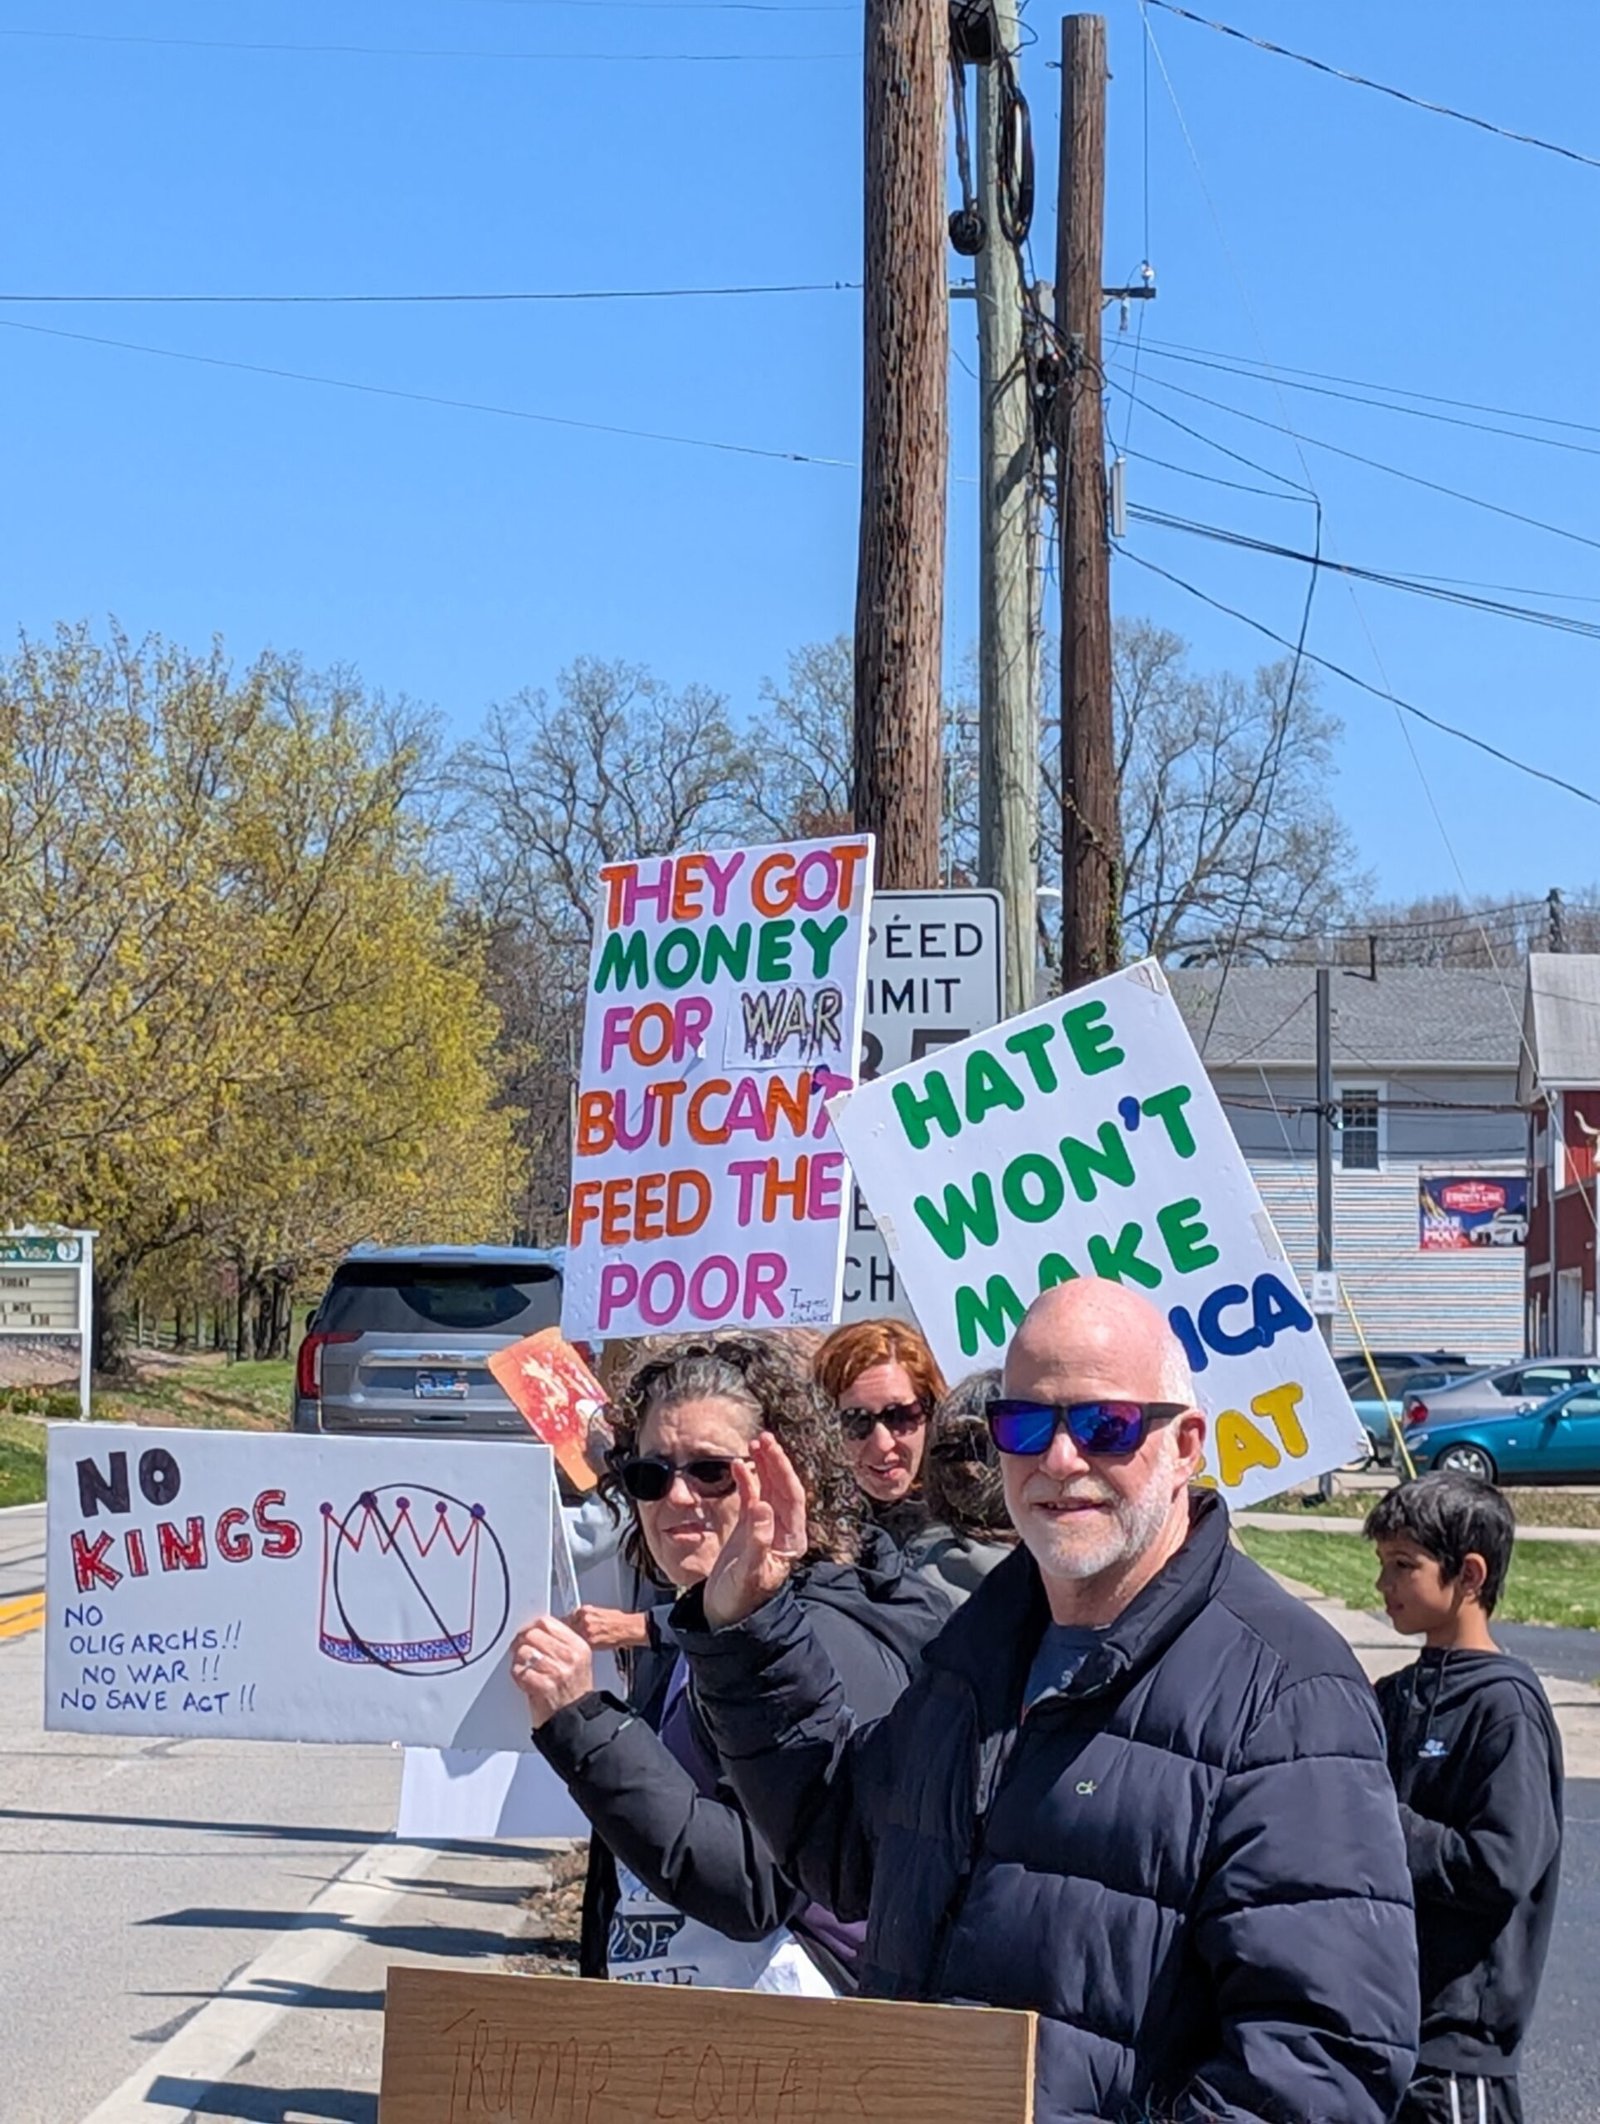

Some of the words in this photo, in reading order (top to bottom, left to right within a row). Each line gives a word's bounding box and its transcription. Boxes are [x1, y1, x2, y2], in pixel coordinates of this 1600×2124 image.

[600, 851, 745, 930] THEY
[751, 845, 868, 918] GOT
[594, 915, 848, 994] MONEY
[868, 923, 984, 959] EED
[601, 996, 713, 1073] FOR
[741, 987, 843, 1062] WAR
[868, 978, 961, 1015] IMIT
[576, 1079, 688, 1157] BUT
[687, 1064, 854, 1145] CAN'T
[892, 1000, 1125, 1149] HATE
[570, 1169, 712, 1248] FEED
[727, 1152, 844, 1227] THE
[913, 1085, 1197, 1260] WON'T
[598, 1252, 788, 1330] POOR
[76, 1448, 181, 1518] NO
[70, 1489, 302, 1594] KINGS
[65, 1603, 103, 1627] NO
[70, 1620, 242, 1655] OLIGARCHS!!
[61, 1688, 95, 1711] NO
[106, 1690, 168, 1711] SAVE
[82, 1664, 115, 1685] NO
